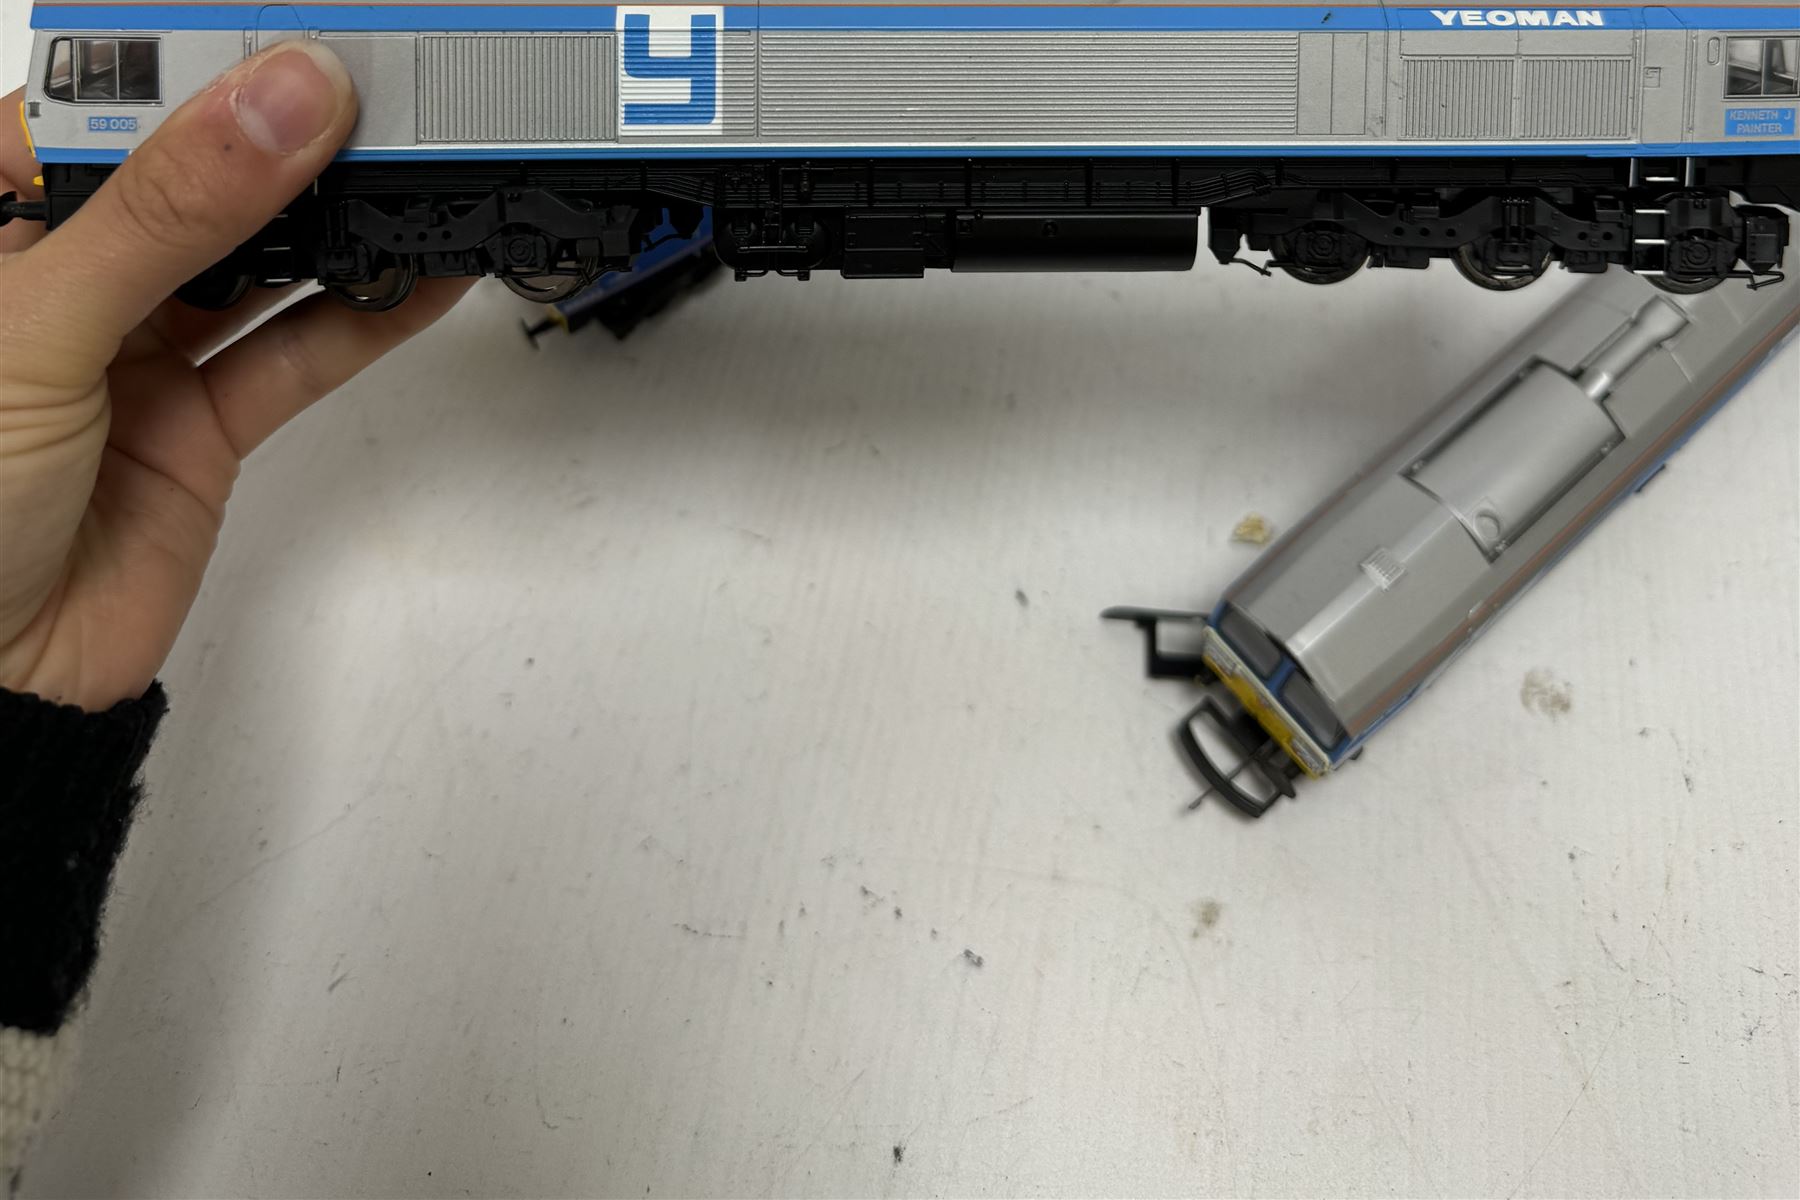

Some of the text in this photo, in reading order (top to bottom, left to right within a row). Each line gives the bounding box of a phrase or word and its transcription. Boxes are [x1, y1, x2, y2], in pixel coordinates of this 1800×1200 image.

[1430, 10, 1604, 27] YEOMAN
[1728, 110, 1793, 121] KENNETH J
[90, 118, 137, 130] 59 005
[1736, 123, 1783, 134] PAINTER
